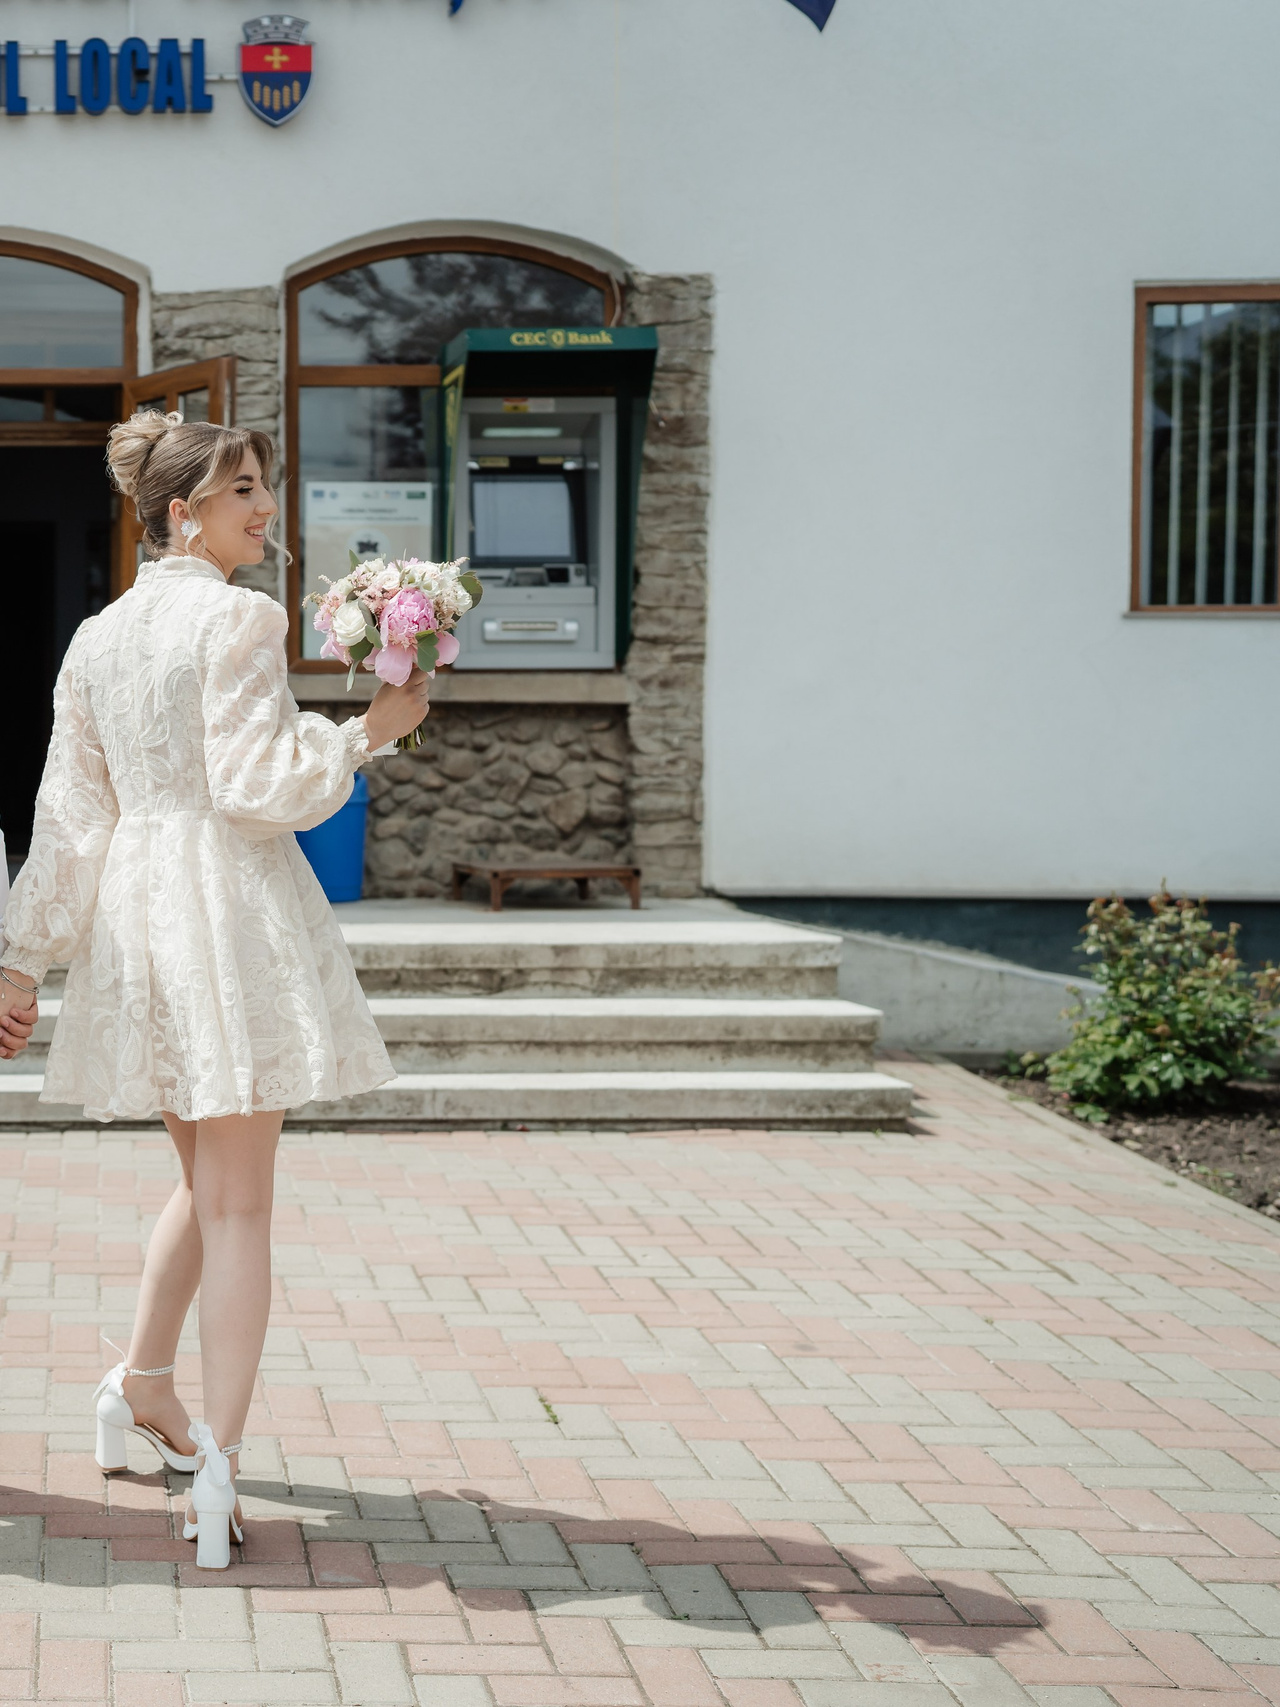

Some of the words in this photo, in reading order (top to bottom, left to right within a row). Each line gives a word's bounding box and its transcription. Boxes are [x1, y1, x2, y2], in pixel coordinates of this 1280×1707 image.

[54, 37, 214, 116] LOCAL
[510, 332, 547, 346] CEC
[568, 331, 613, 345] Bank
